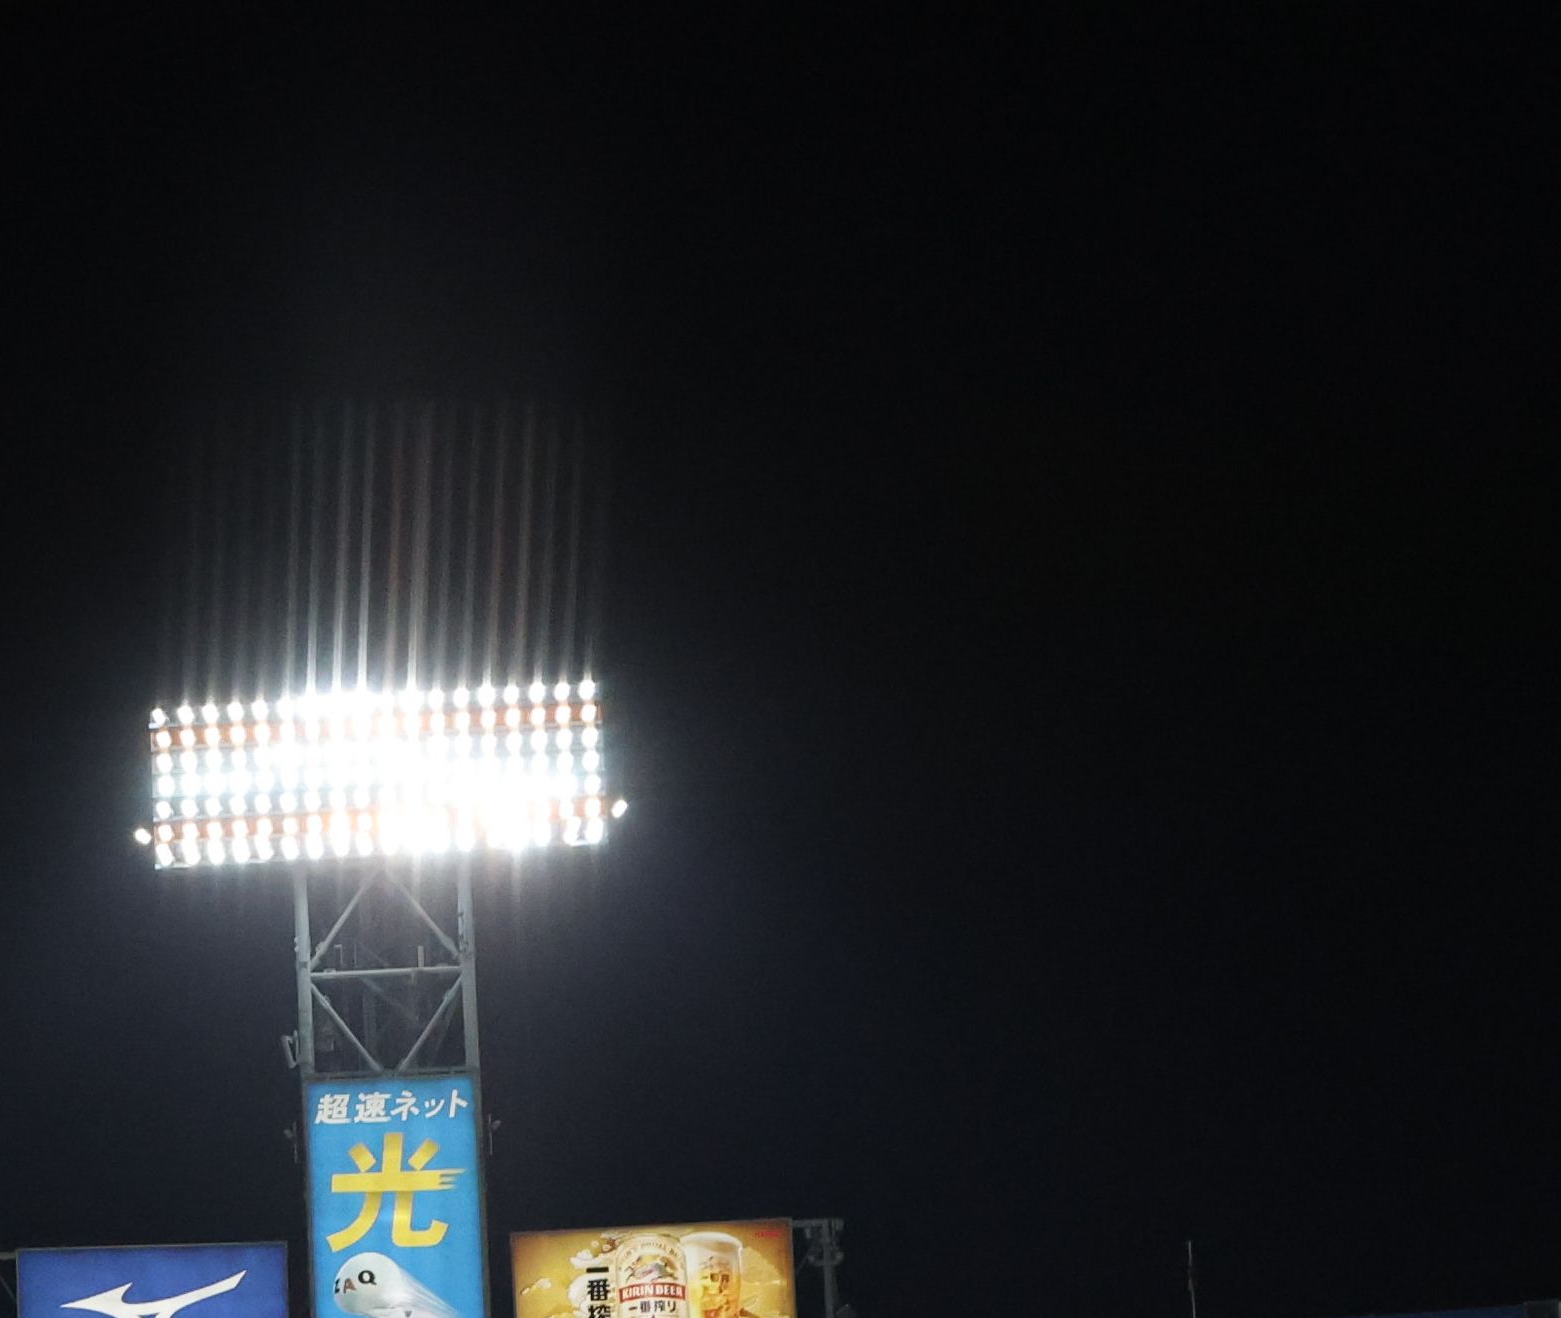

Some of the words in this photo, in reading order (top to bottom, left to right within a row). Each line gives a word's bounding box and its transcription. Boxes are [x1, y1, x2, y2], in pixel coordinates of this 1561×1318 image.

[314, 1089, 469, 1125] 超速ネット
[326, 1132, 467, 1253] 光
[622, 1285, 654, 1299] KIRIN
[655, 1284, 683, 1298] BEER
[628, 1300, 677, 1313] 一番搾り
